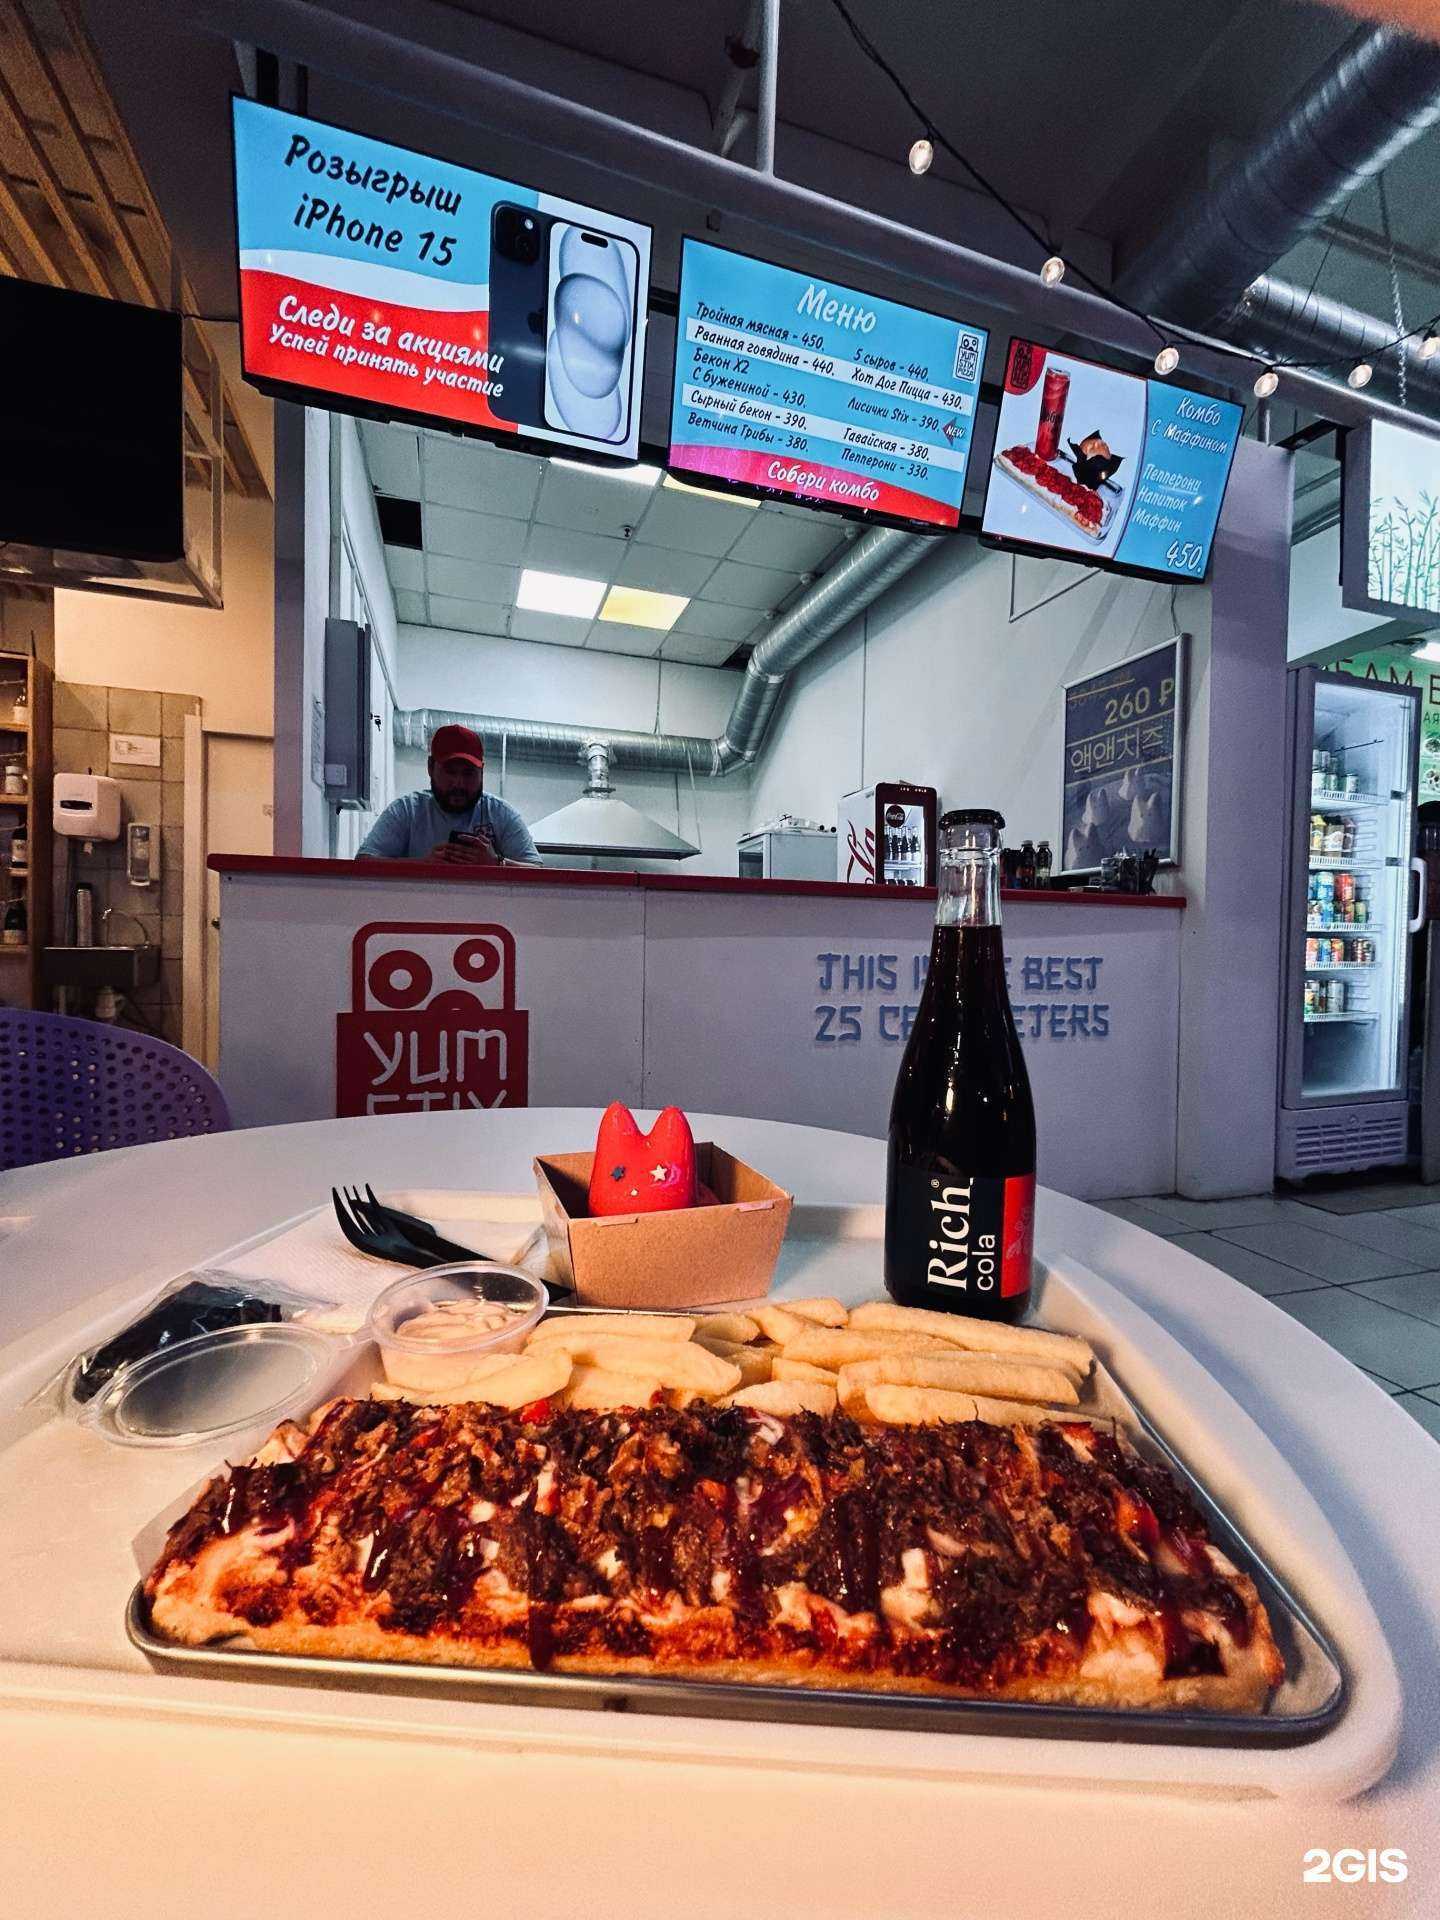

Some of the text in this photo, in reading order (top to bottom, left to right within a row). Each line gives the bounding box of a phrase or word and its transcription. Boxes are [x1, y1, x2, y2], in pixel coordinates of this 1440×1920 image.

[284, 134, 463, 216] Розыгрыш
[293, 193, 457, 266] iPhone 15
[696, 302, 744, 327] Тройная
[745, 320, 789, 340] мясная
[802, 332, 825, 351] 450.
[796, 283, 877, 334] Меню
[278, 295, 504, 374] Следи за акциями
[695, 325, 744, 351] Рванная
[747, 345, 800, 366] говядина
[812, 358, 835, 376] 440.
[268, 323, 504, 398] Успей принять участие
[693, 347, 731, 370] Бекон
[853, 348, 863, 361] 5
[863, 354, 896, 371] сыров
[908, 363, 929, 382] 440.
[693, 367, 701, 380] С
[703, 369, 770, 398] бужениной
[783, 390, 806, 408] 430.
[851, 367, 874, 383] Хот
[875, 375, 896, 391] Дог
[899, 380, 930, 401] Пицца
[942, 392, 963, 410] 430.
[691, 390, 736, 412] Сырный
[739, 401, 771, 421] бекон
[784, 412, 807, 430] 390.
[848, 397, 889, 417] Лисички
[891, 408, 910, 424] Stix
[919, 415, 940, 432] 390.
[1177, 396, 1222, 426] Комбо
[688, 412, 738, 434] Ветчина
[741, 424, 774, 443] Грибы
[786, 435, 808, 452] 380.
[843, 427, 897, 452] Гавайская
[907, 443, 930, 461] 380.
[946, 427, 965, 438] NEW
[1164, 423, 1228, 454] Маффином
[767, 461, 879, 501] Собери комбо
[841, 447, 897, 472] Пепперони
[907, 463, 929, 480] 330.
[1143, 463, 1202, 492] Пепперони
[1138, 485, 1188, 512] Напиток
[1132, 508, 1182, 533] Маффин
[1166, 540, 1203, 573] 450.
[1104, 687, 1150, 725] 260
[816, 952, 898, 991] THIS
[1022, 955, 1104, 991] BEST
[814, 1004, 863, 1042] 25
[971, 1234, 995, 1291] cola
